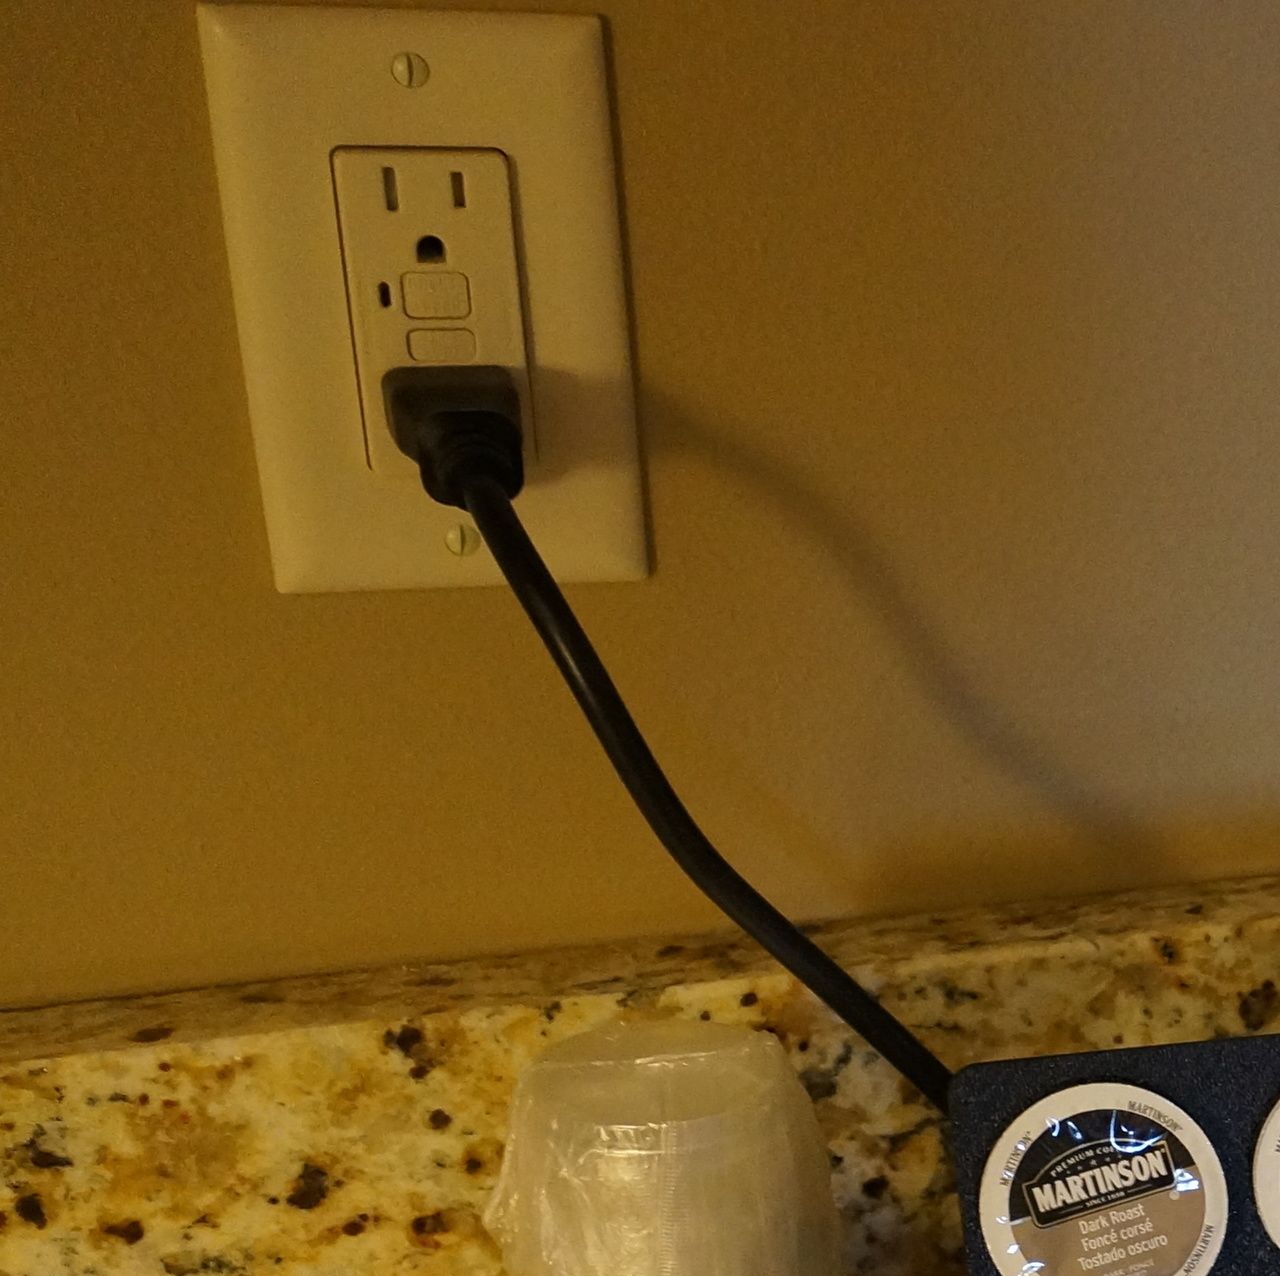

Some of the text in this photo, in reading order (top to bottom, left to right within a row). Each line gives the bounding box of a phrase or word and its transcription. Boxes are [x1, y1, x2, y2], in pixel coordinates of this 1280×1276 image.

[1000, 1132, 1031, 1187] MRTINON
[1051, 1148, 1096, 1178] PREMIUM
[1032, 1150, 1170, 1213] MARTINSON
[1078, 1204, 1146, 1236] Dark Roast
[1080, 1217, 1154, 1252] Foncé corsé
[1077, 1234, 1169, 1272] Tostado oscuro
